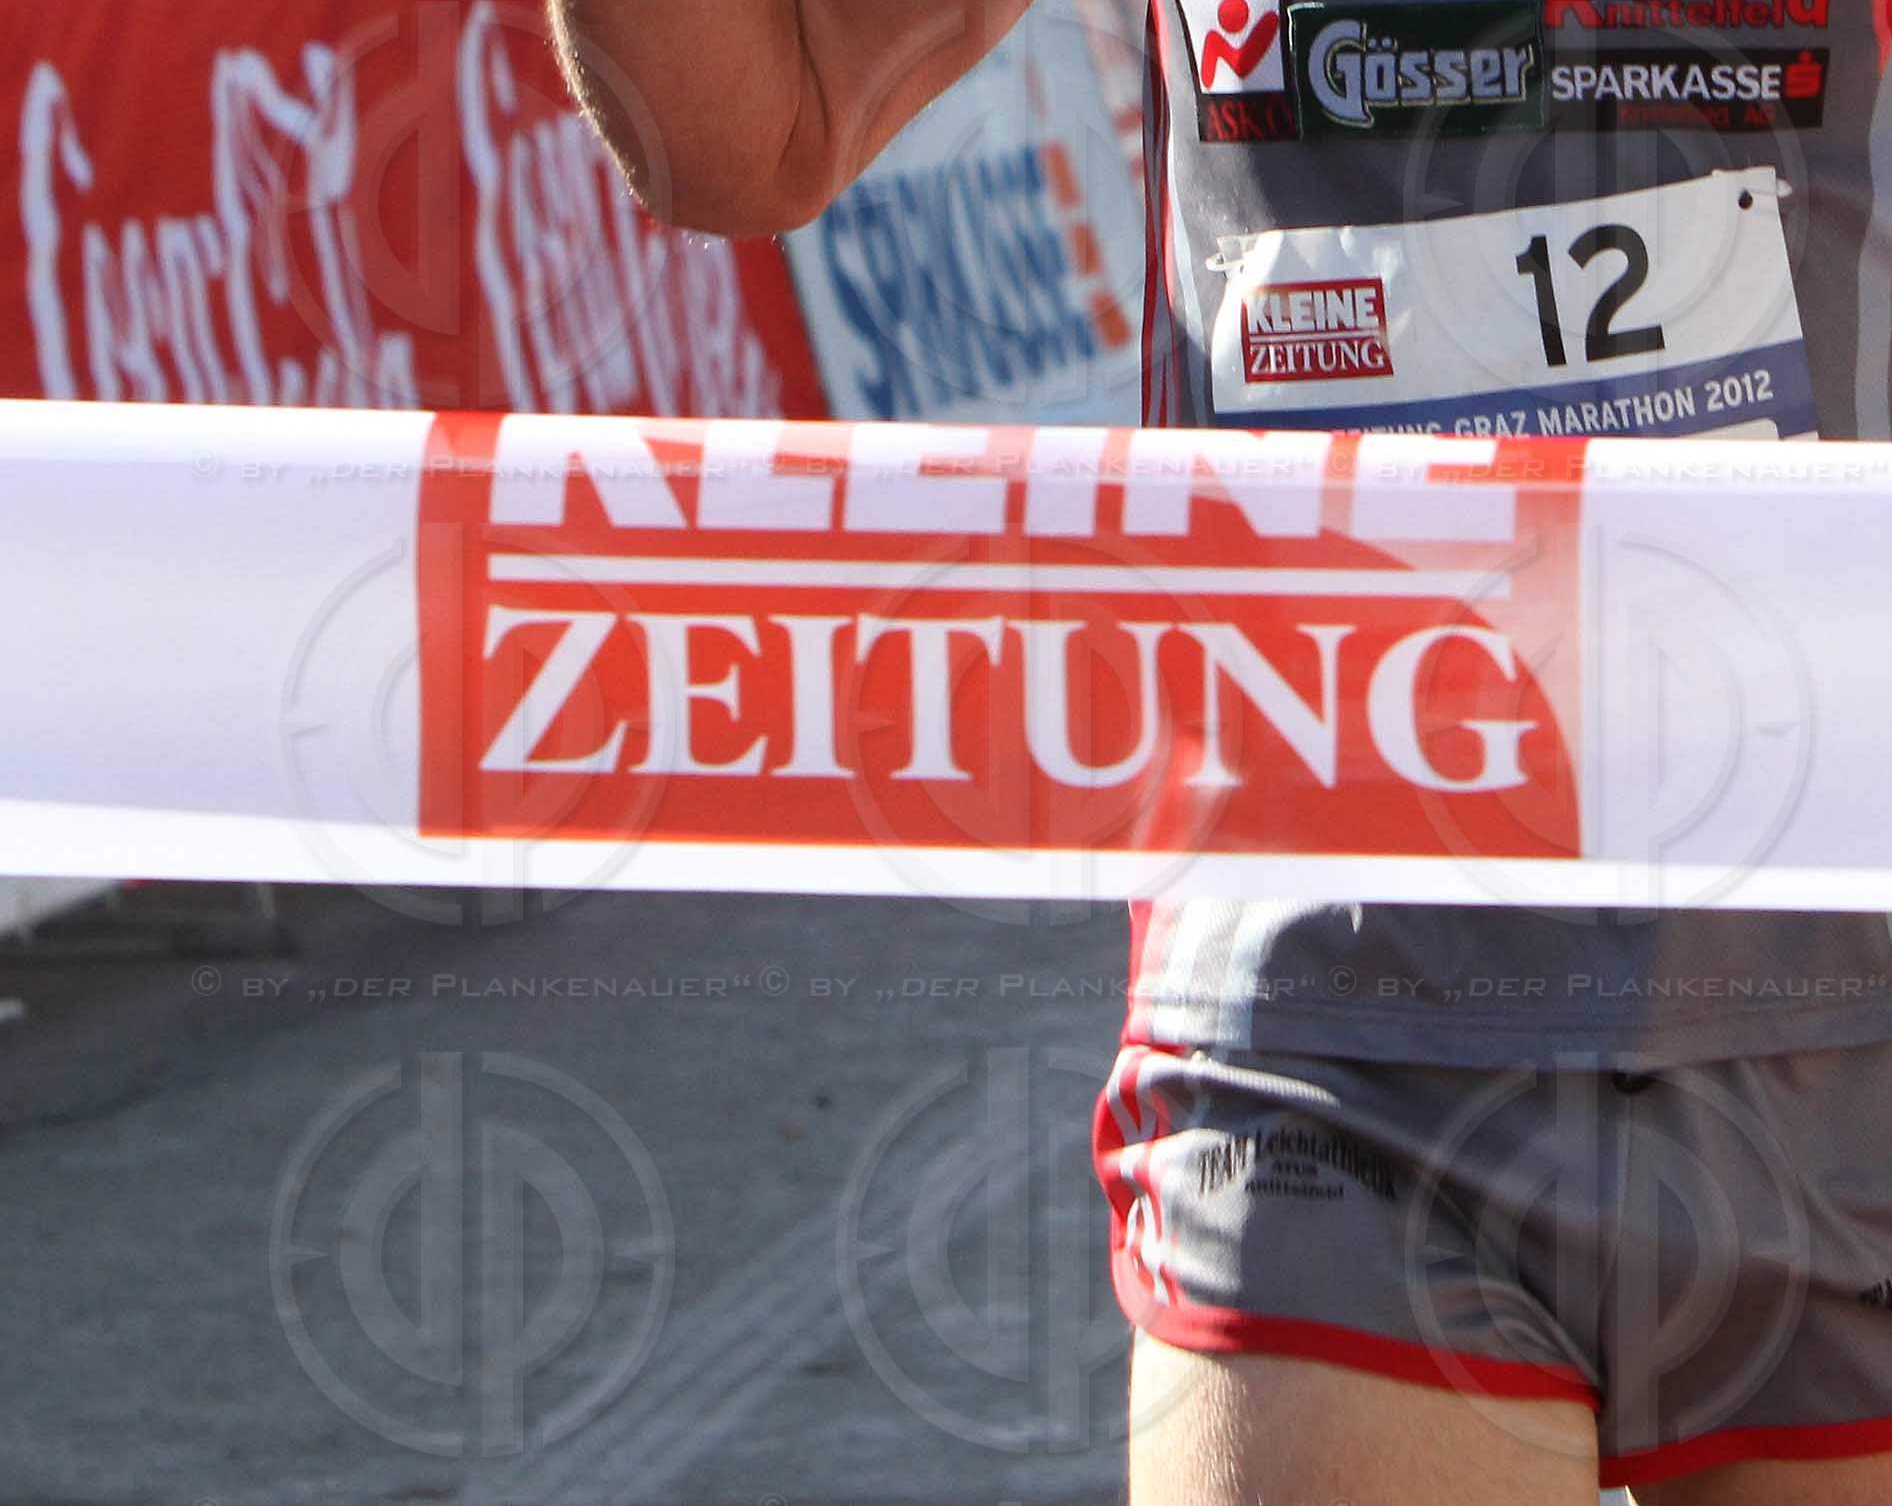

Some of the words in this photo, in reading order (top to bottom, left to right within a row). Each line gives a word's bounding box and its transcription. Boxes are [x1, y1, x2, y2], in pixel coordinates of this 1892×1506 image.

[1308, 19, 1534, 129] Gösser
[1551, 63, 1782, 101] SPARKASSE
[1248, 288, 1380, 335] KLEINE
[1516, 223, 1666, 367] 12
[1250, 339, 1385, 375] ZEITUNG
[1454, 411, 1528, 437] GRAZ
[1536, 387, 1697, 437] MARATHON
[1704, 369, 1775, 412] 2012
[487, 416, 1514, 544] KLEINE
[479, 607, 1540, 795] ZEITUNG
